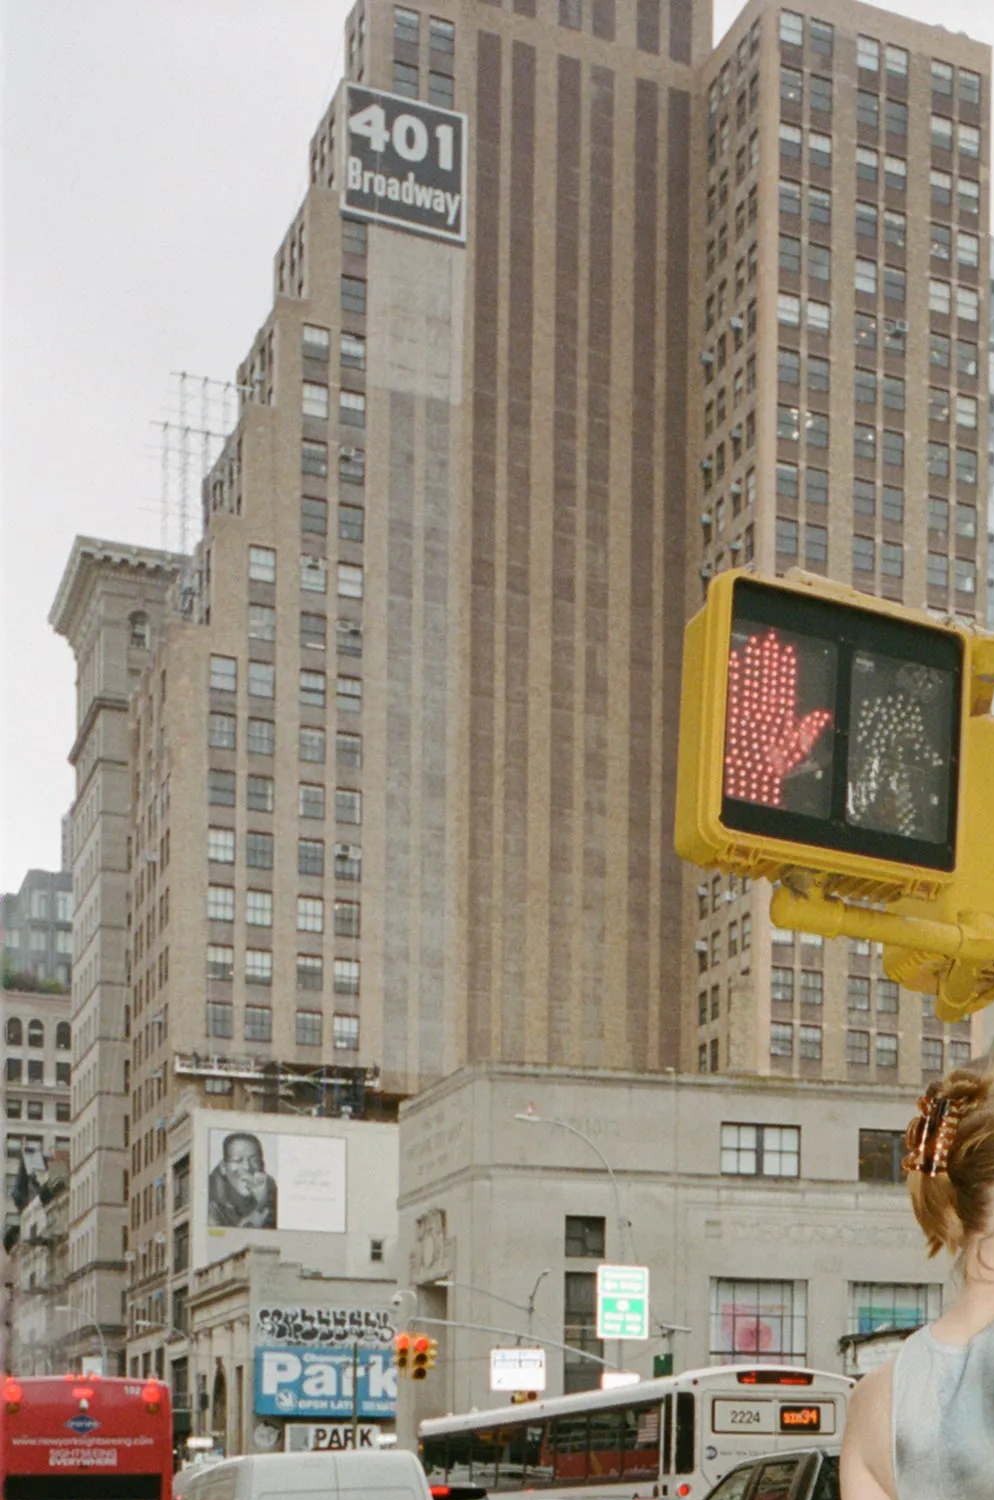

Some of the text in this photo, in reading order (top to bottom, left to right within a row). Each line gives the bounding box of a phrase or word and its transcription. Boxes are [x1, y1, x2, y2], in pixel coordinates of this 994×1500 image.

[348, 103, 455, 172] 401
[347, 155, 462, 226] Broadway
[262, 1351, 397, 1398] Park
[315, 1428, 373, 1448] PARK
[730, 1410, 760, 1424] 2224
